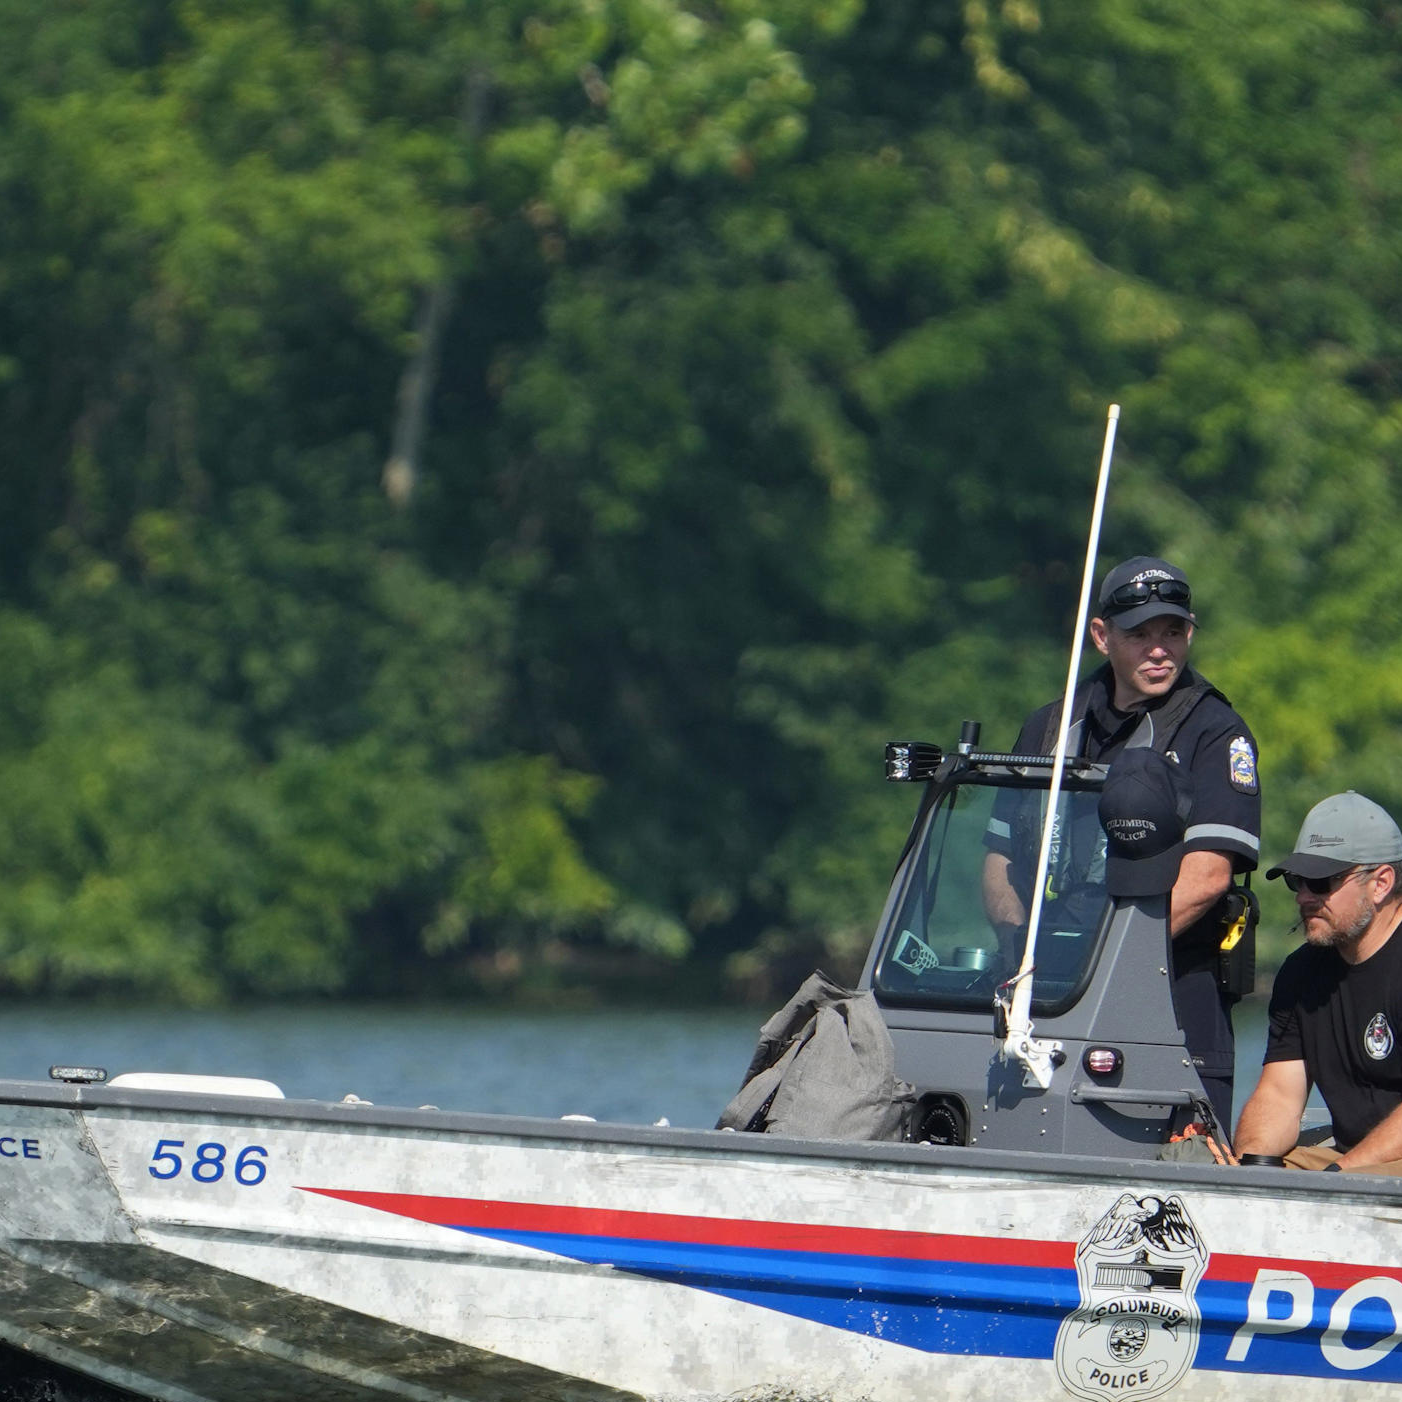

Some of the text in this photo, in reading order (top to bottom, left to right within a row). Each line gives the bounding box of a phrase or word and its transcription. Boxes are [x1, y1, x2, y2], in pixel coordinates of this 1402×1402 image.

[1106, 819, 1157, 832] COLUMBUS
[148, 1140, 269, 1186] 586
[1096, 1300, 1181, 1321] COLUMBUS
[1090, 1368, 1149, 1388] POLICE
